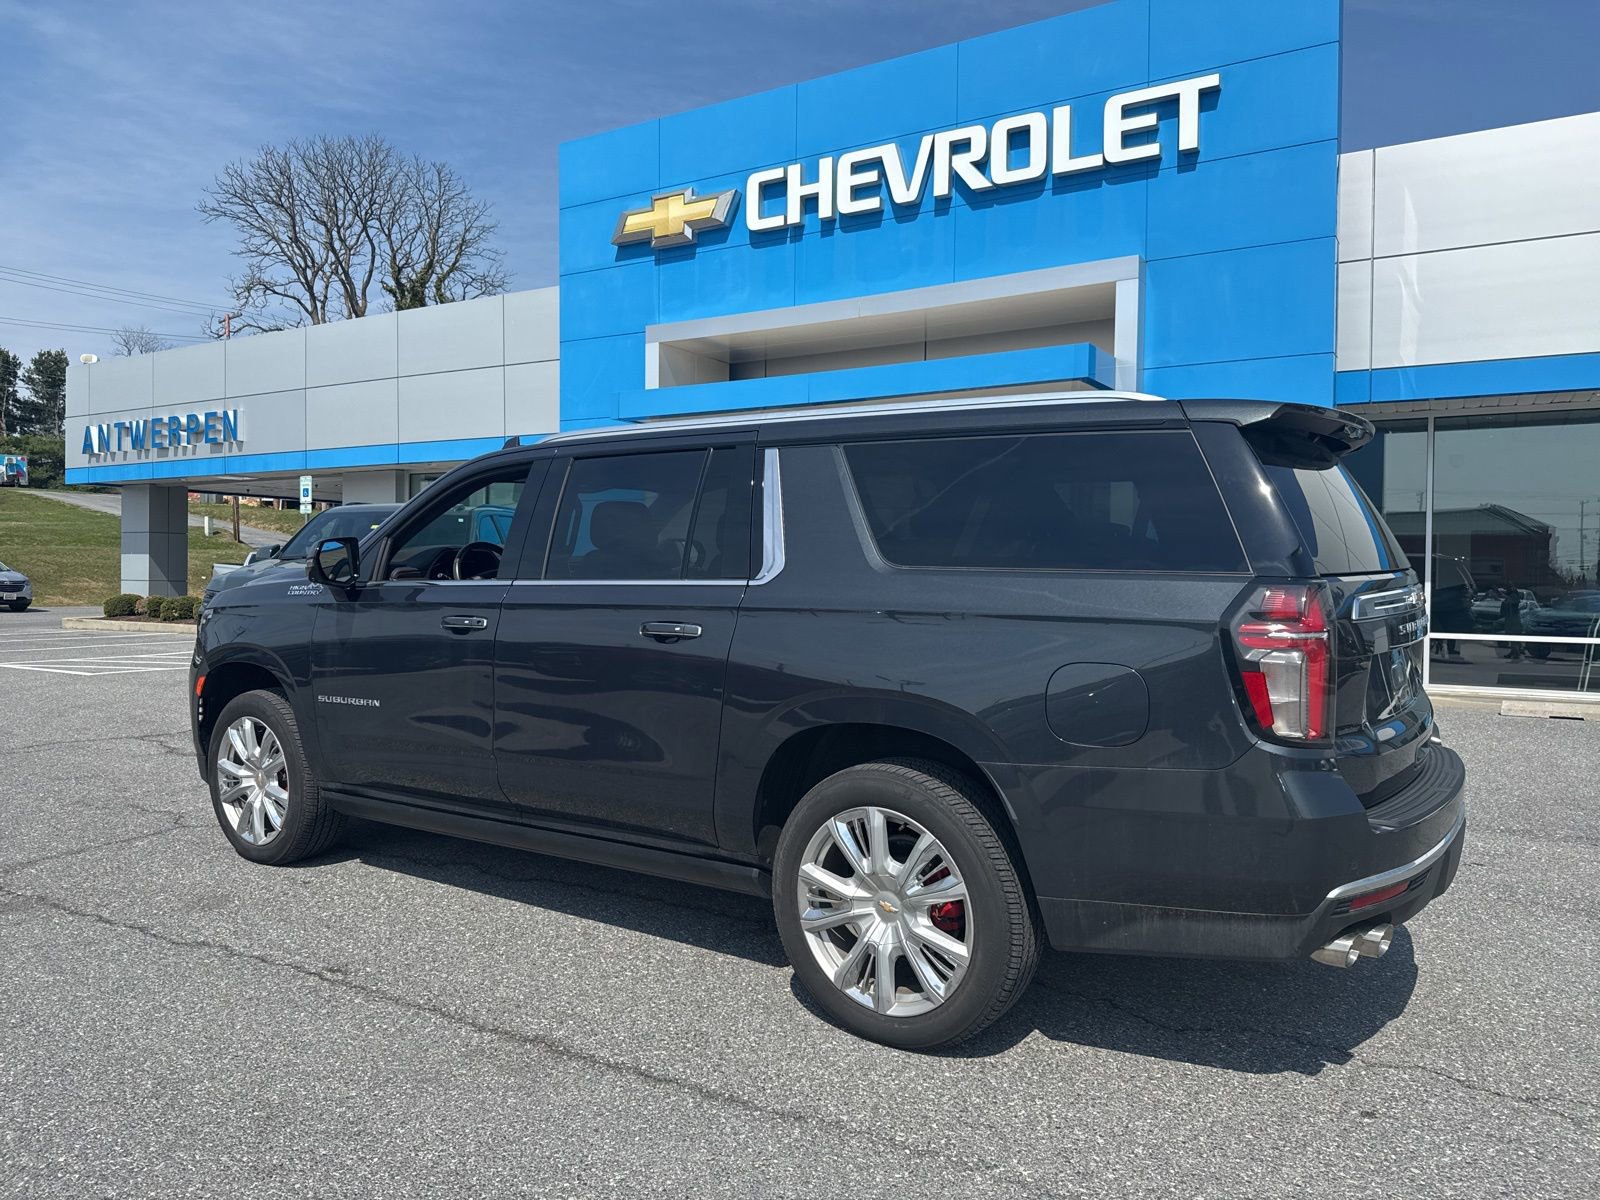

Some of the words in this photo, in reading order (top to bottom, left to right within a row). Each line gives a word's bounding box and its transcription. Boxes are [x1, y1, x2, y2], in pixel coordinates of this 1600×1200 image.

[746, 73, 1220, 232] CHEVROLET
[82, 409, 239, 455] ANTWERPEN
[318, 695, 380, 707] SUBURBAN
